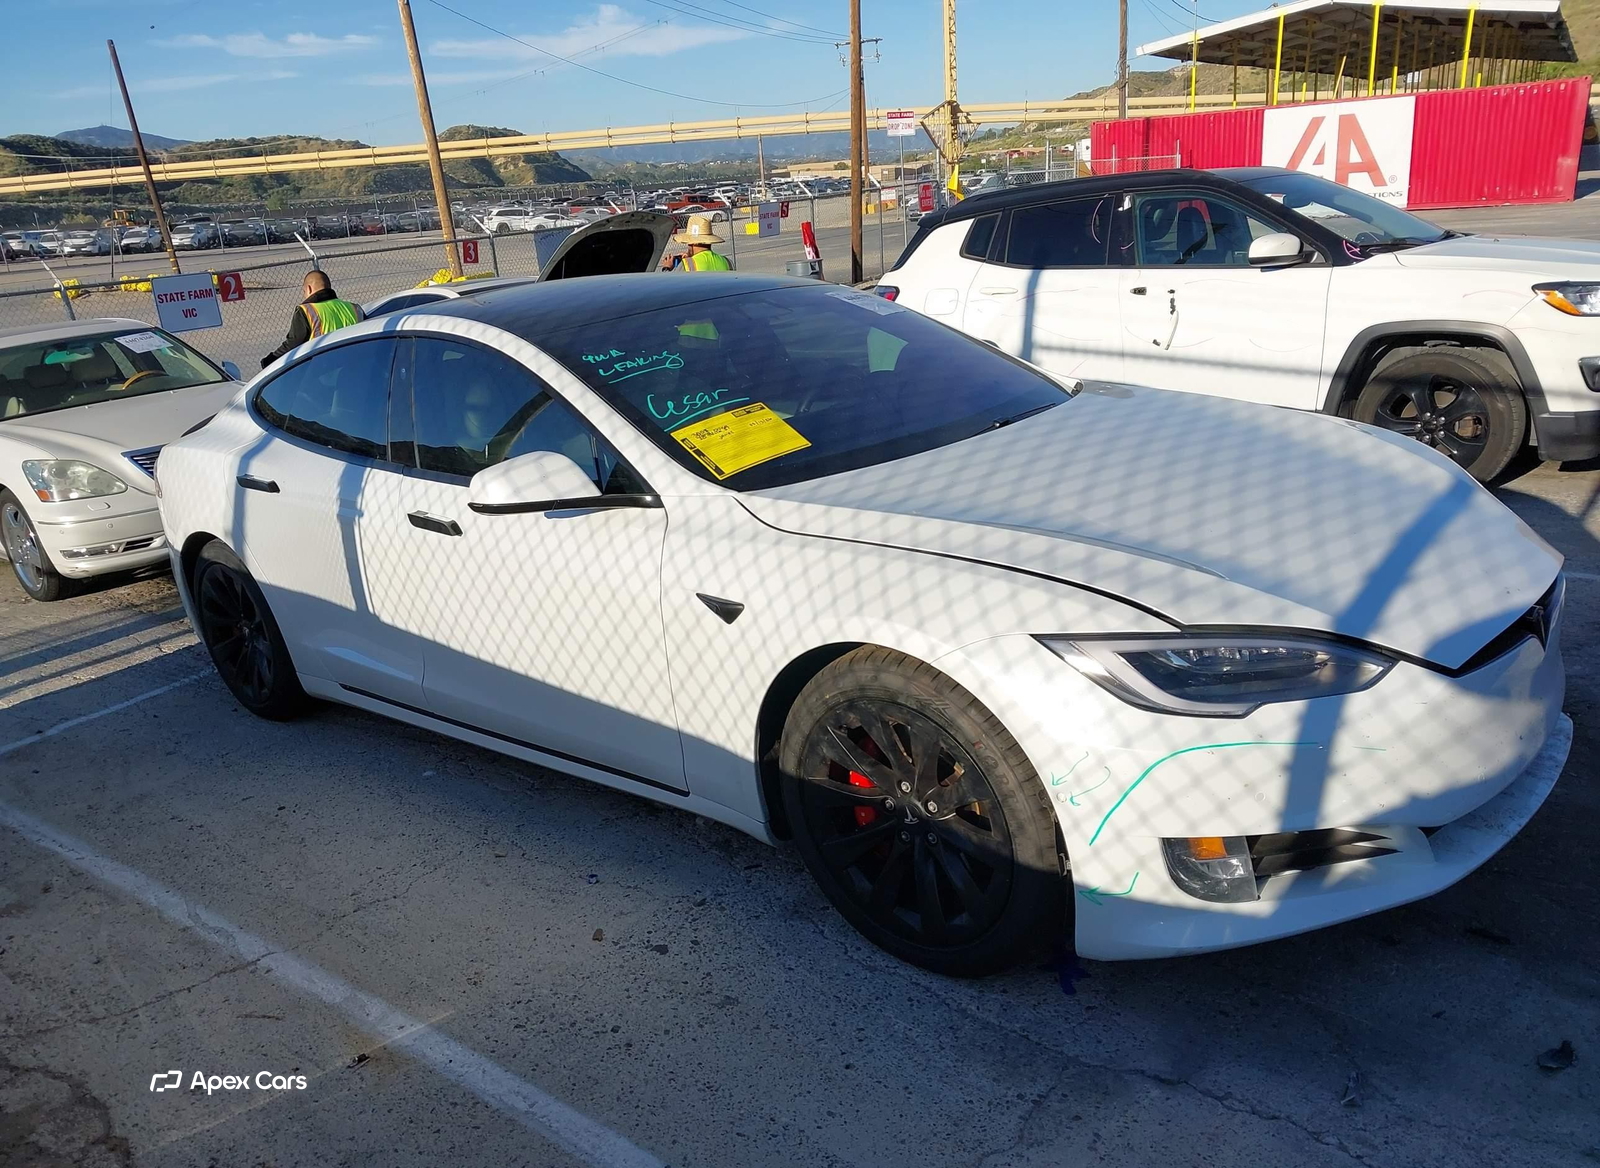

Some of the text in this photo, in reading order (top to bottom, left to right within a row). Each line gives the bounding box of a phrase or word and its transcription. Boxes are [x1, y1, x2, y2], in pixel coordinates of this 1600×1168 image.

[466, 242, 475, 262] 3
[157, 288, 214, 304] STATE FARM
[223, 276, 239, 300] 2
[182, 308, 198, 318] VIC
